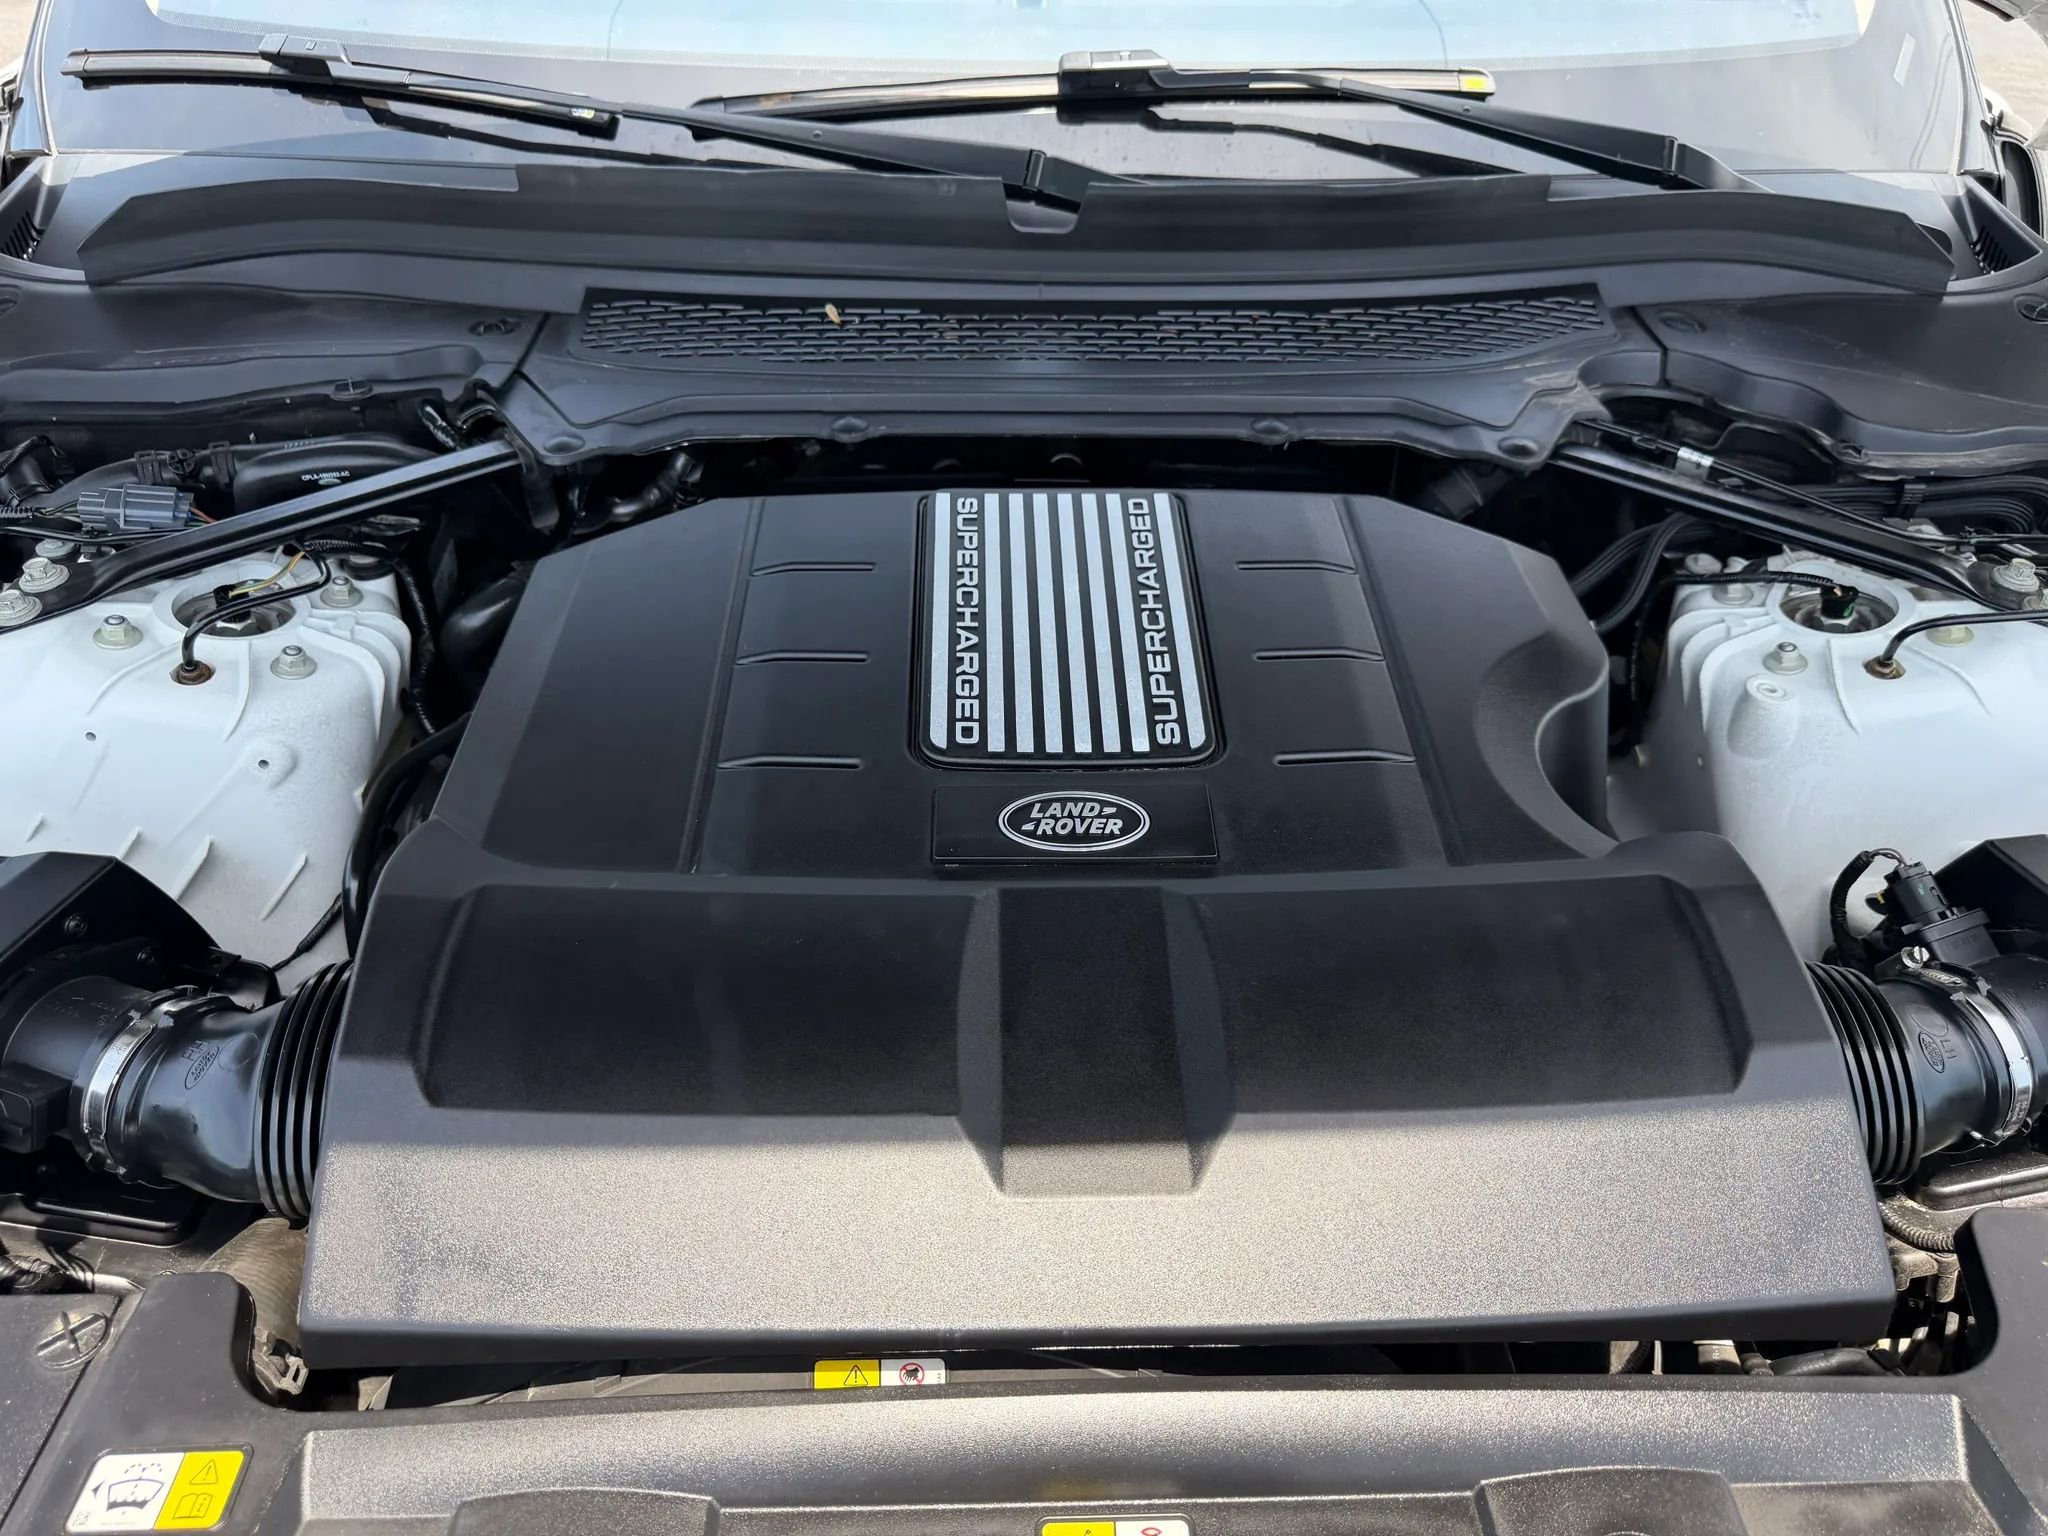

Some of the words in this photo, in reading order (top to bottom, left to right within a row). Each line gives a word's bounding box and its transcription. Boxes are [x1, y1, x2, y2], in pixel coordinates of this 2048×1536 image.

[956, 497, 980, 744] SUPERCHARGED
[1128, 498, 1181, 744] SUPERCHARGED
[1030, 802, 1100, 818] LAND
[1036, 818, 1123, 835] ROVER
[1940, 1040, 1957, 1059] LH
